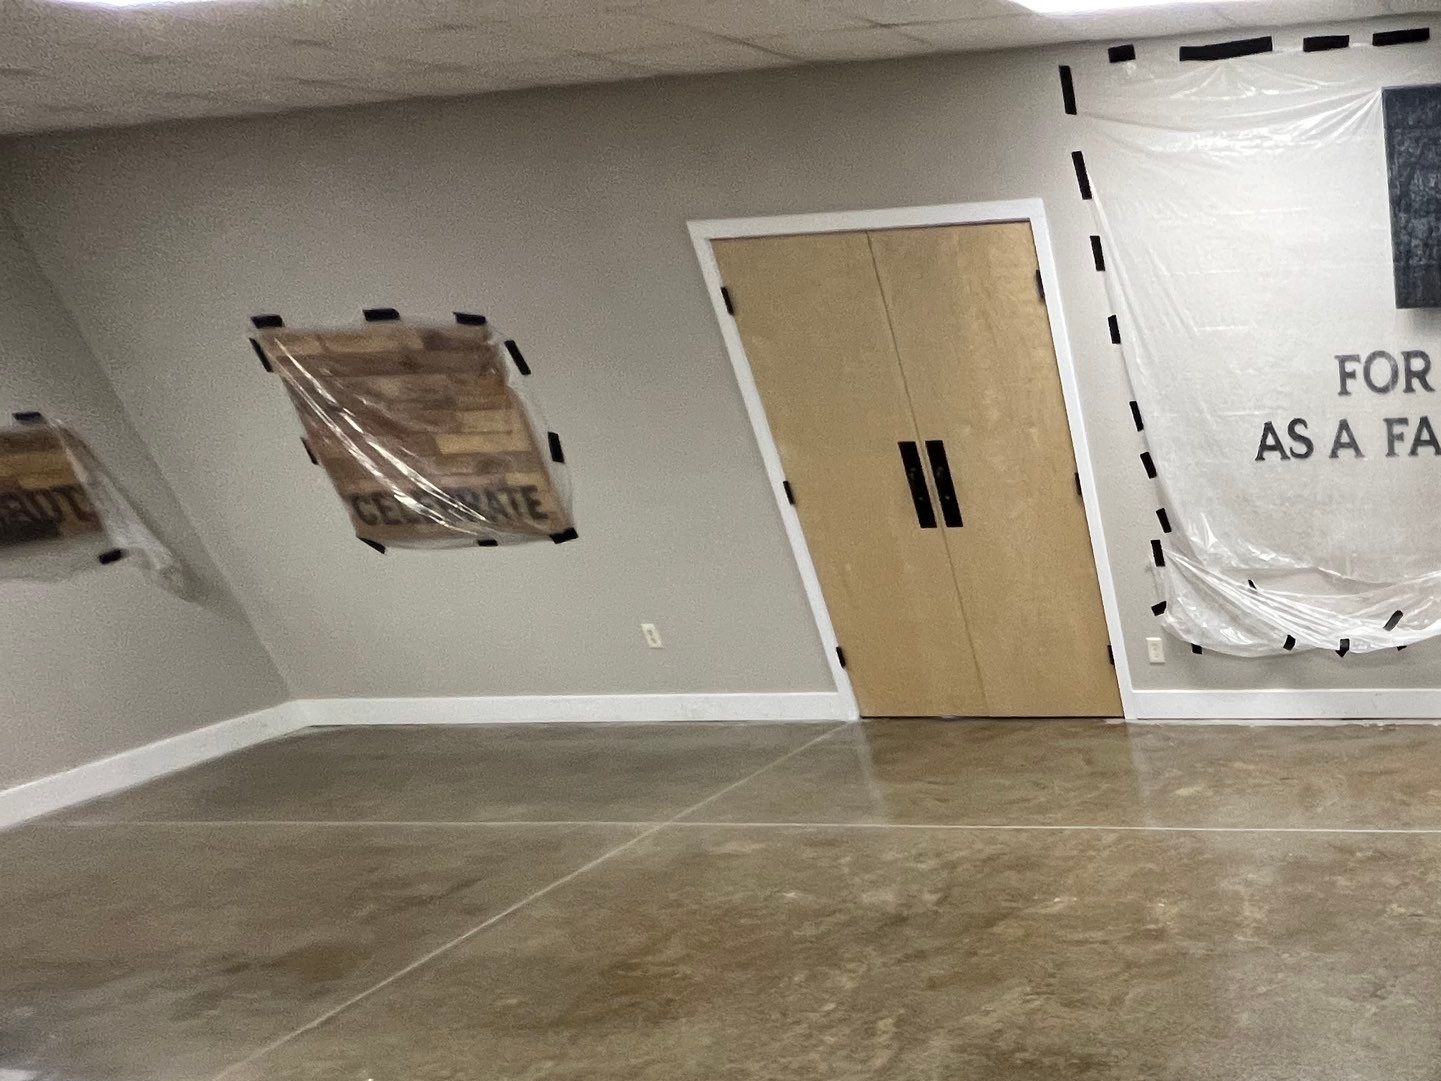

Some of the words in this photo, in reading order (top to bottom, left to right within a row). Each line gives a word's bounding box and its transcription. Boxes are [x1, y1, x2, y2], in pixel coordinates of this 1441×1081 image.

[1334, 350, 1435, 396] FOR
[1255, 417, 1314, 461] AS
[1328, 418, 1365, 459] A
